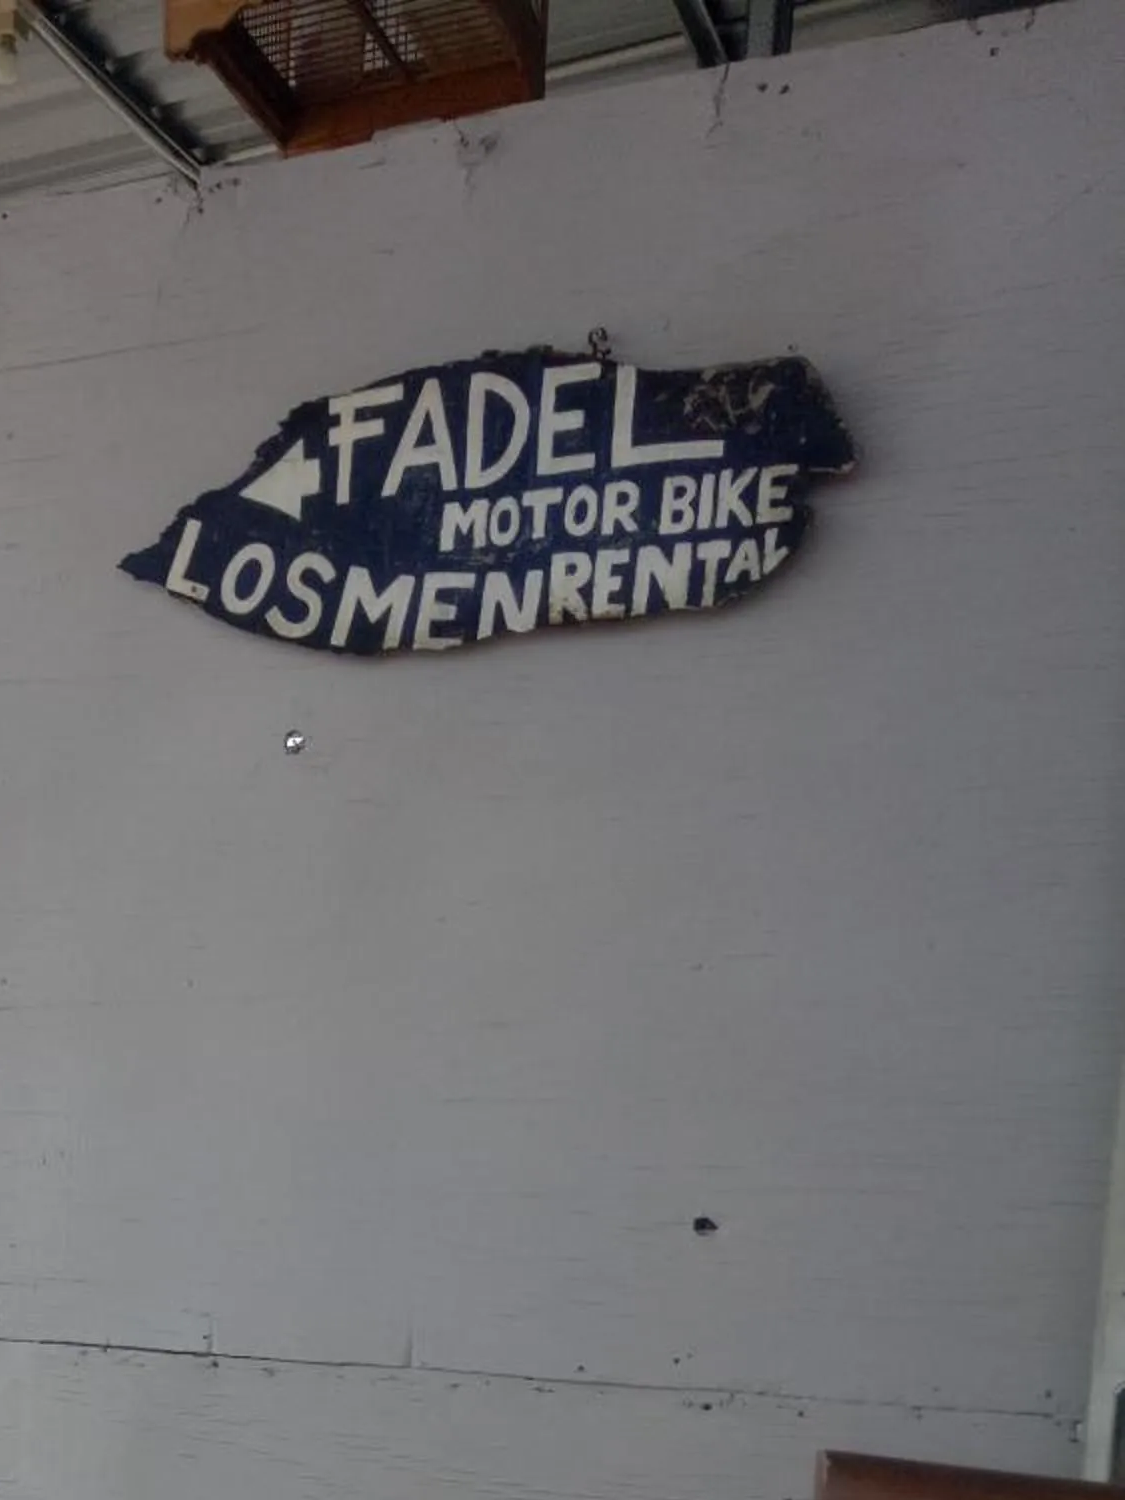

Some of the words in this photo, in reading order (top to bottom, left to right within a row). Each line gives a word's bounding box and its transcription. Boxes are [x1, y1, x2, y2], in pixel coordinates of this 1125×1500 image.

[328, 363, 724, 505] FADEL
[440, 481, 639, 552] MOTOR
[659, 464, 799, 536] BIKE
[166, 520, 543, 650] LOSMEN
[549, 528, 789, 624] RENTAL
